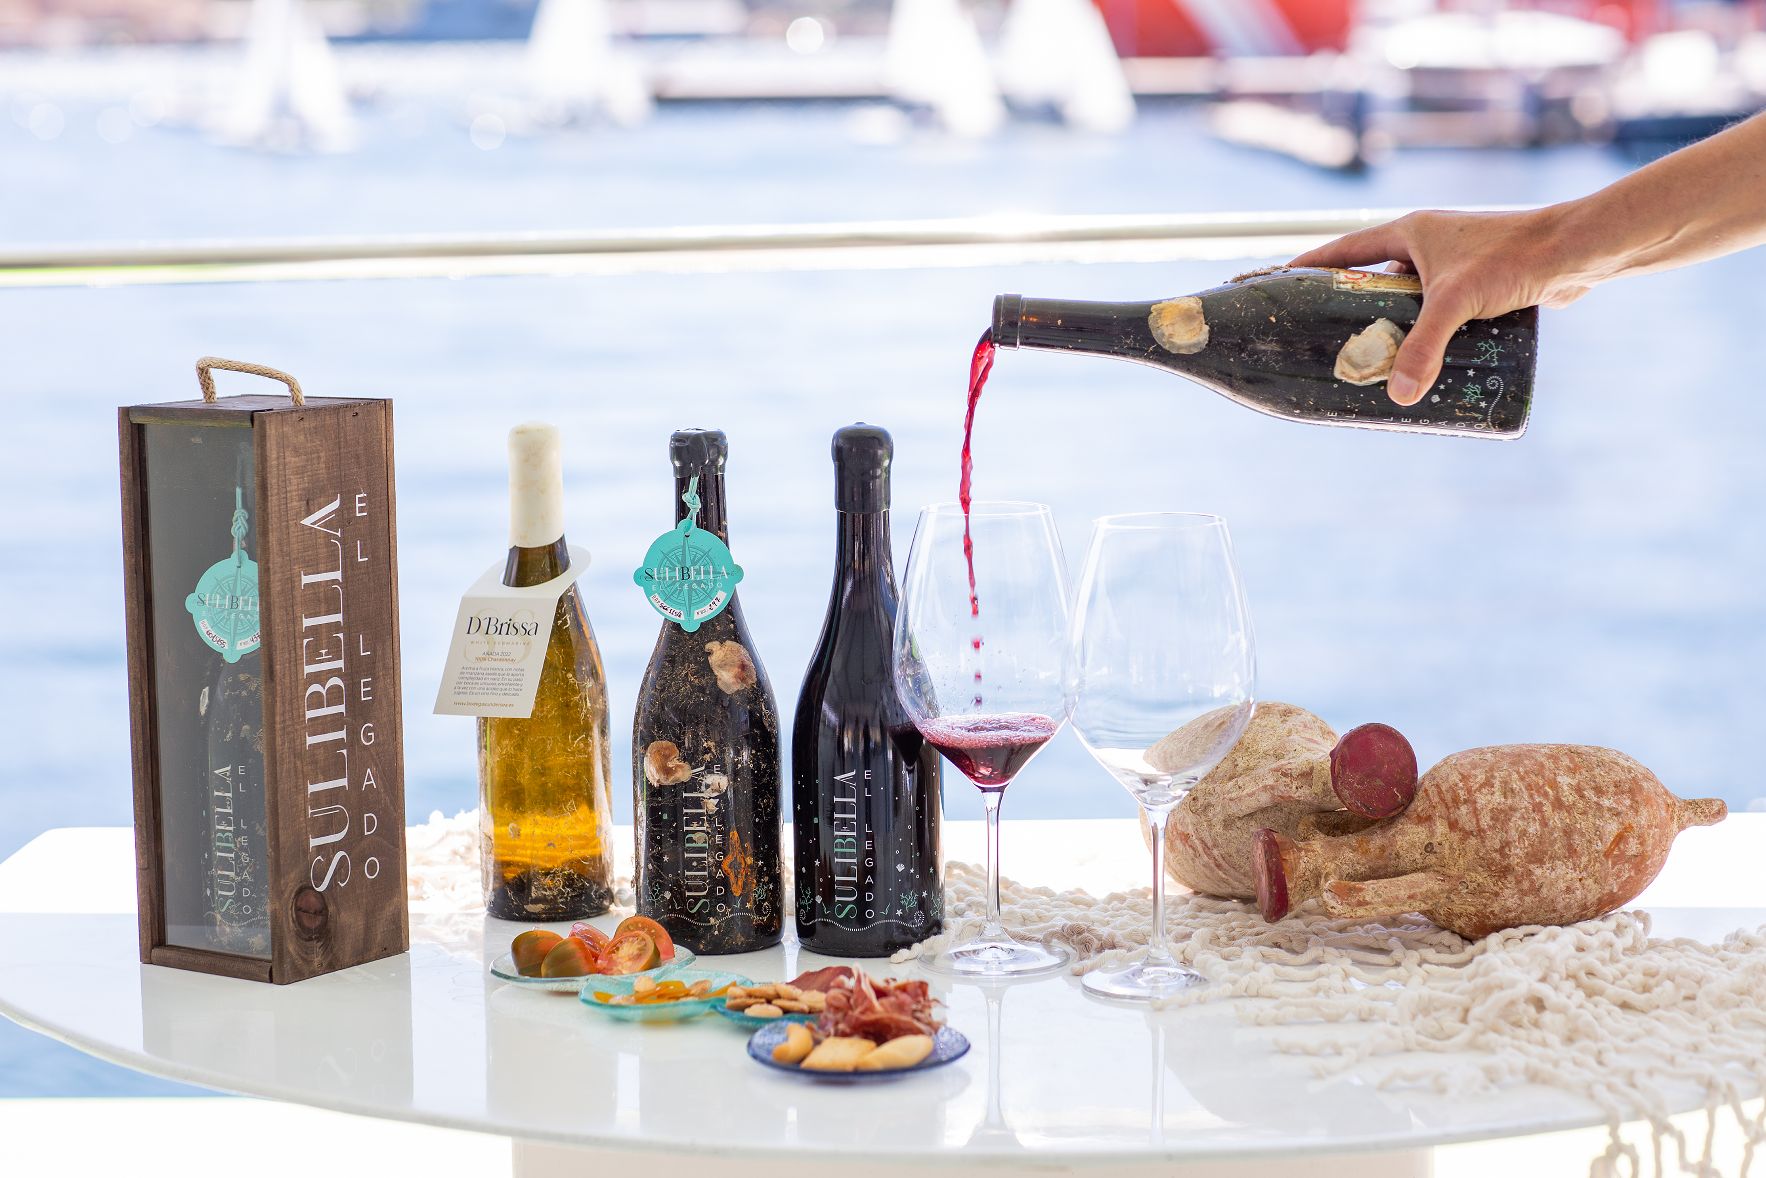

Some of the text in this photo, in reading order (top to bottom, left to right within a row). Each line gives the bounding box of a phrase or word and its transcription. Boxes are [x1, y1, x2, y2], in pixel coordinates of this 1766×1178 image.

[1383, 416, 1485, 430] LEGADO
[644, 565, 729, 581] SULIBELLA
[677, 582, 723, 590] LEGADO
[300, 493, 352, 893] SULIBELLA
[356, 493, 381, 880] EL LEGADO
[213, 763, 237, 913] SULIBELLA
[238, 765, 252, 915] EL LEGADO
[715, 818, 726, 913] LEGADO
[833, 769, 858, 920] SULIBELLA
[864, 769, 875, 919] EL LEGADO
